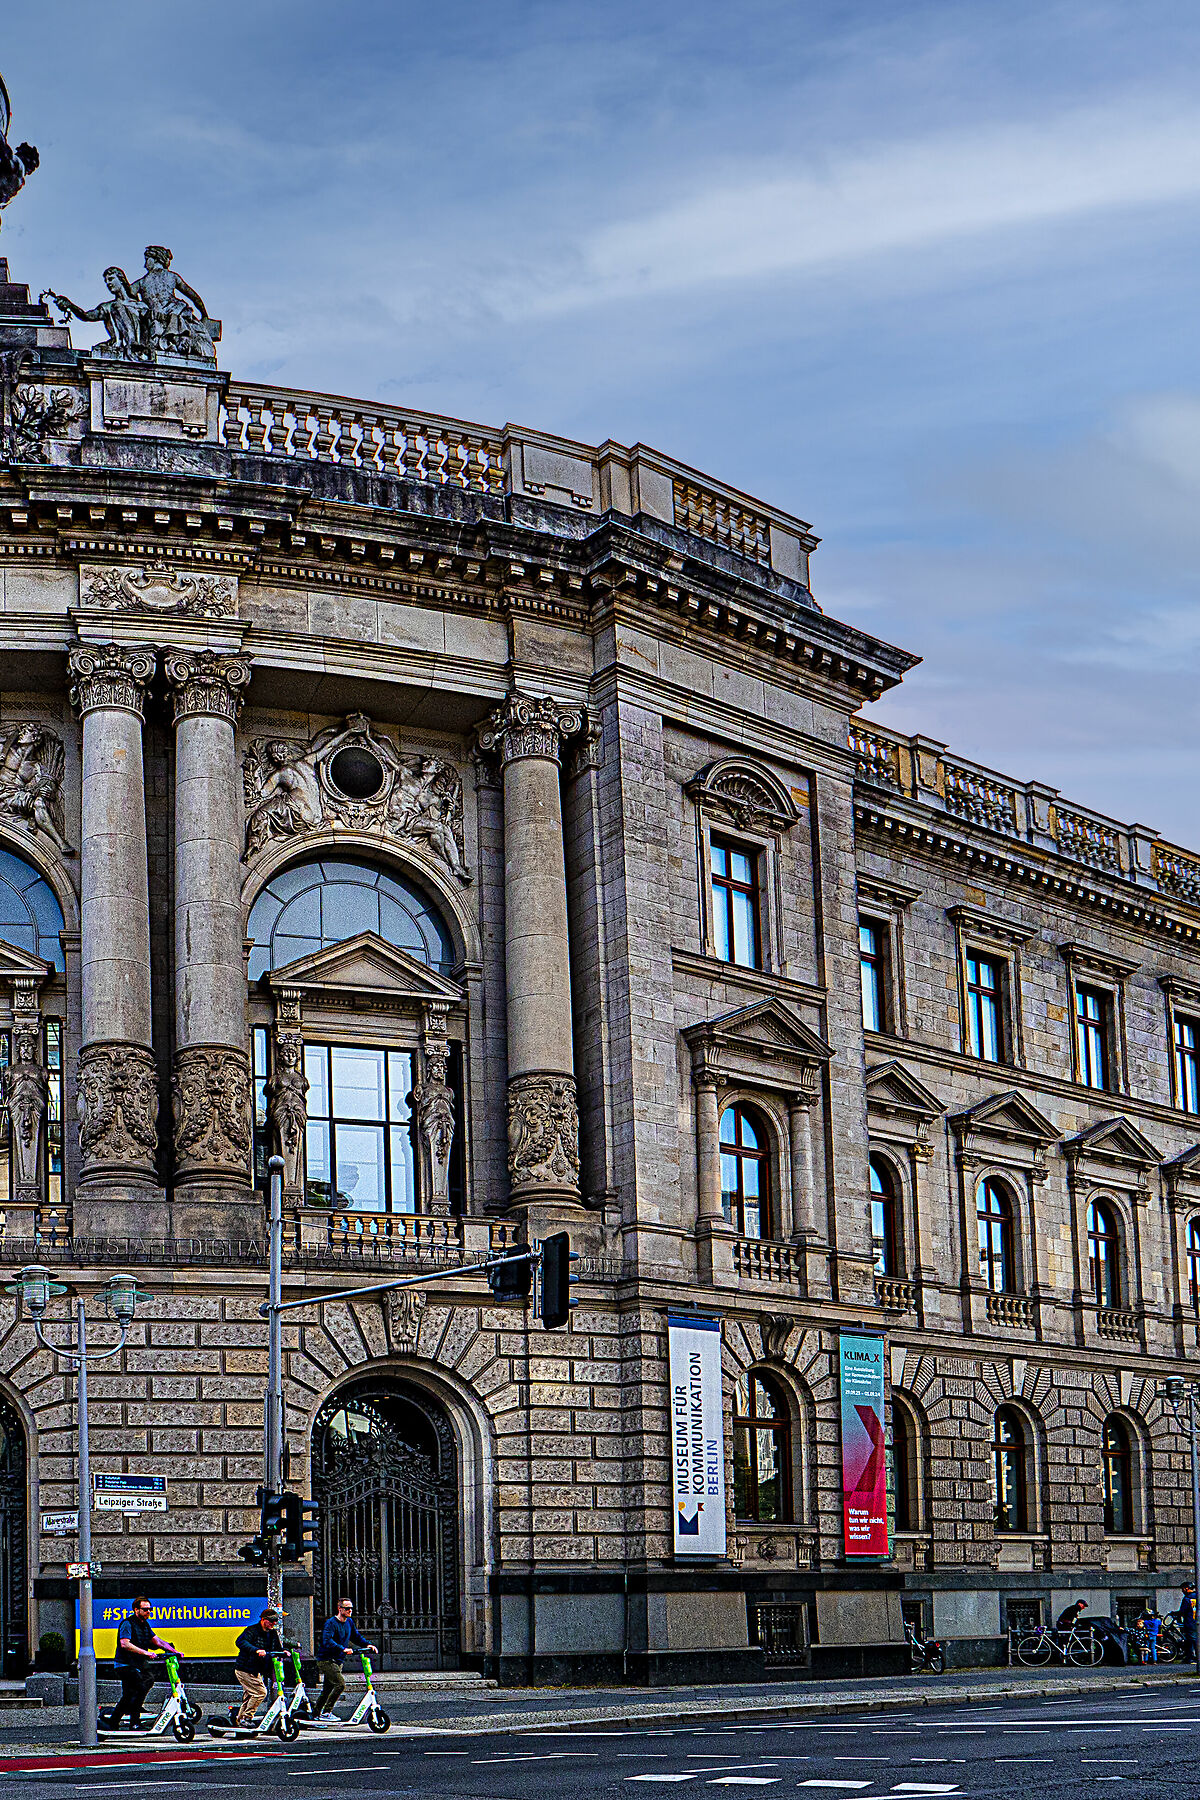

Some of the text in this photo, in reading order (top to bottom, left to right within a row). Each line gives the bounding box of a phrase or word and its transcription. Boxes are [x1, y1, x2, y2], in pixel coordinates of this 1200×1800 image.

[844, 1351, 880, 1363] KLIMA_X
[673, 1385, 690, 1494] MUSEUM FÜR
[690, 1352, 704, 1495] KOMMUNIKATION
[707, 1439, 718, 1495] BERLIN
[99, 1496, 163, 1509] Leipziger Straße
